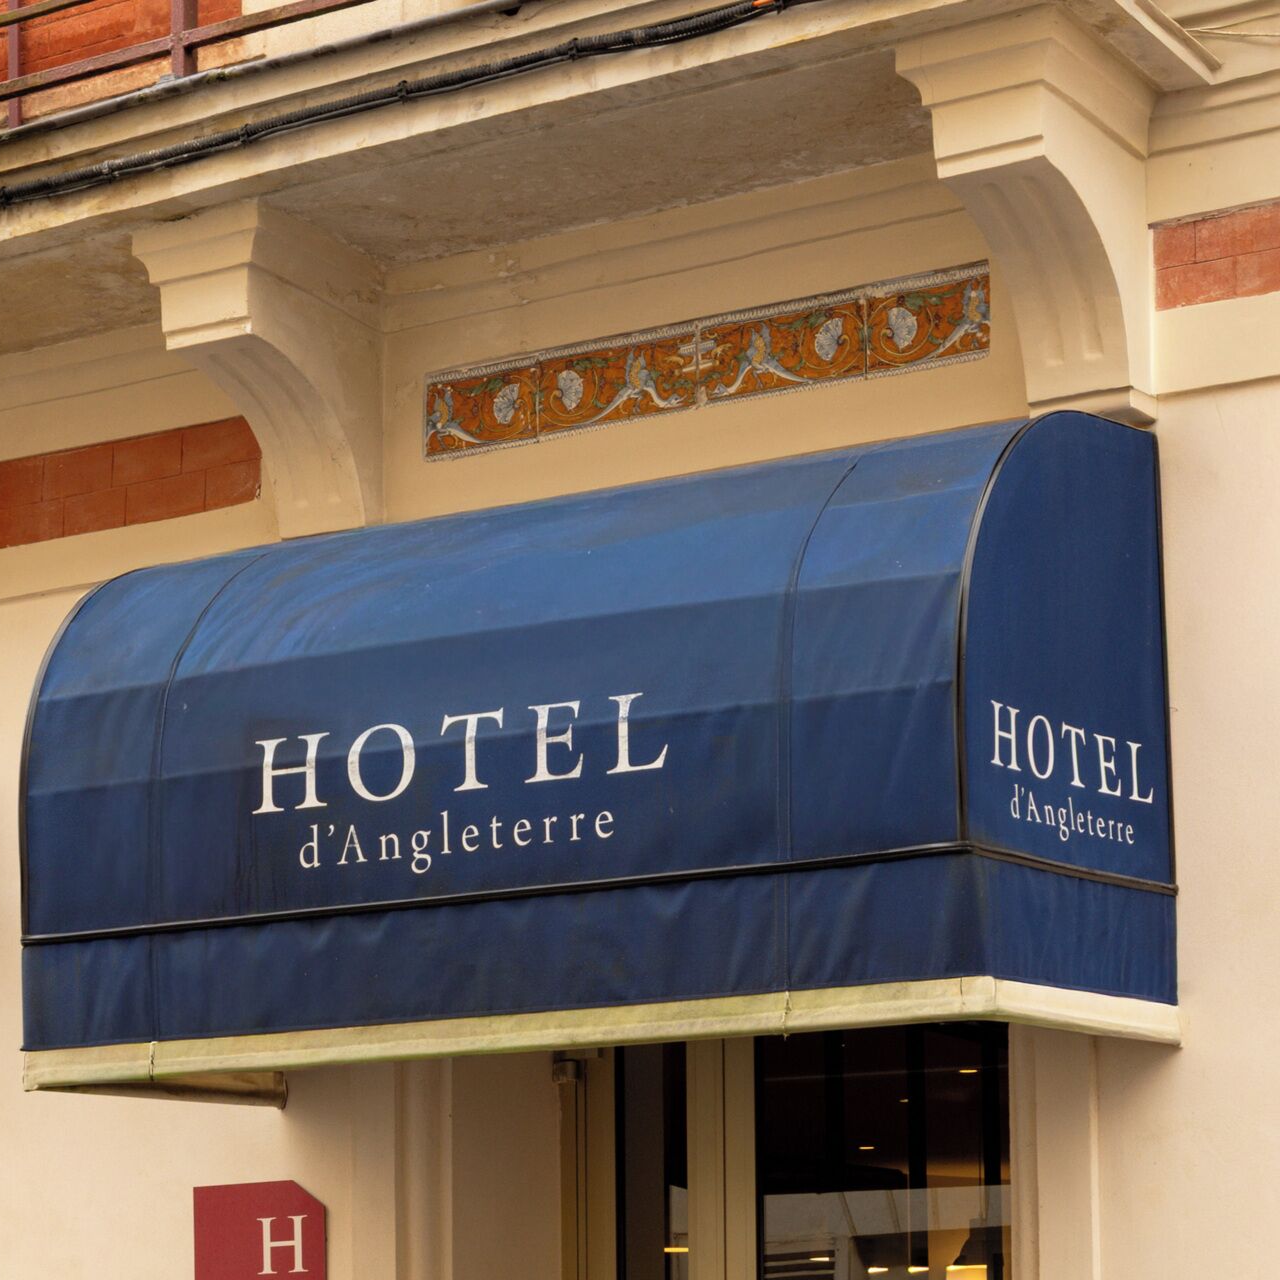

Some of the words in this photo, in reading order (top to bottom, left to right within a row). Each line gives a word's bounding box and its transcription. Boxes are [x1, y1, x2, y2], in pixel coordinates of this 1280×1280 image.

[252, 692, 669, 815] HOTEL
[990, 699, 1154, 804] HOTEL
[298, 810, 615, 874] d'Angleterre
[1010, 783, 1135, 845] d'Angleterre
[256, 1214, 309, 1275] H
